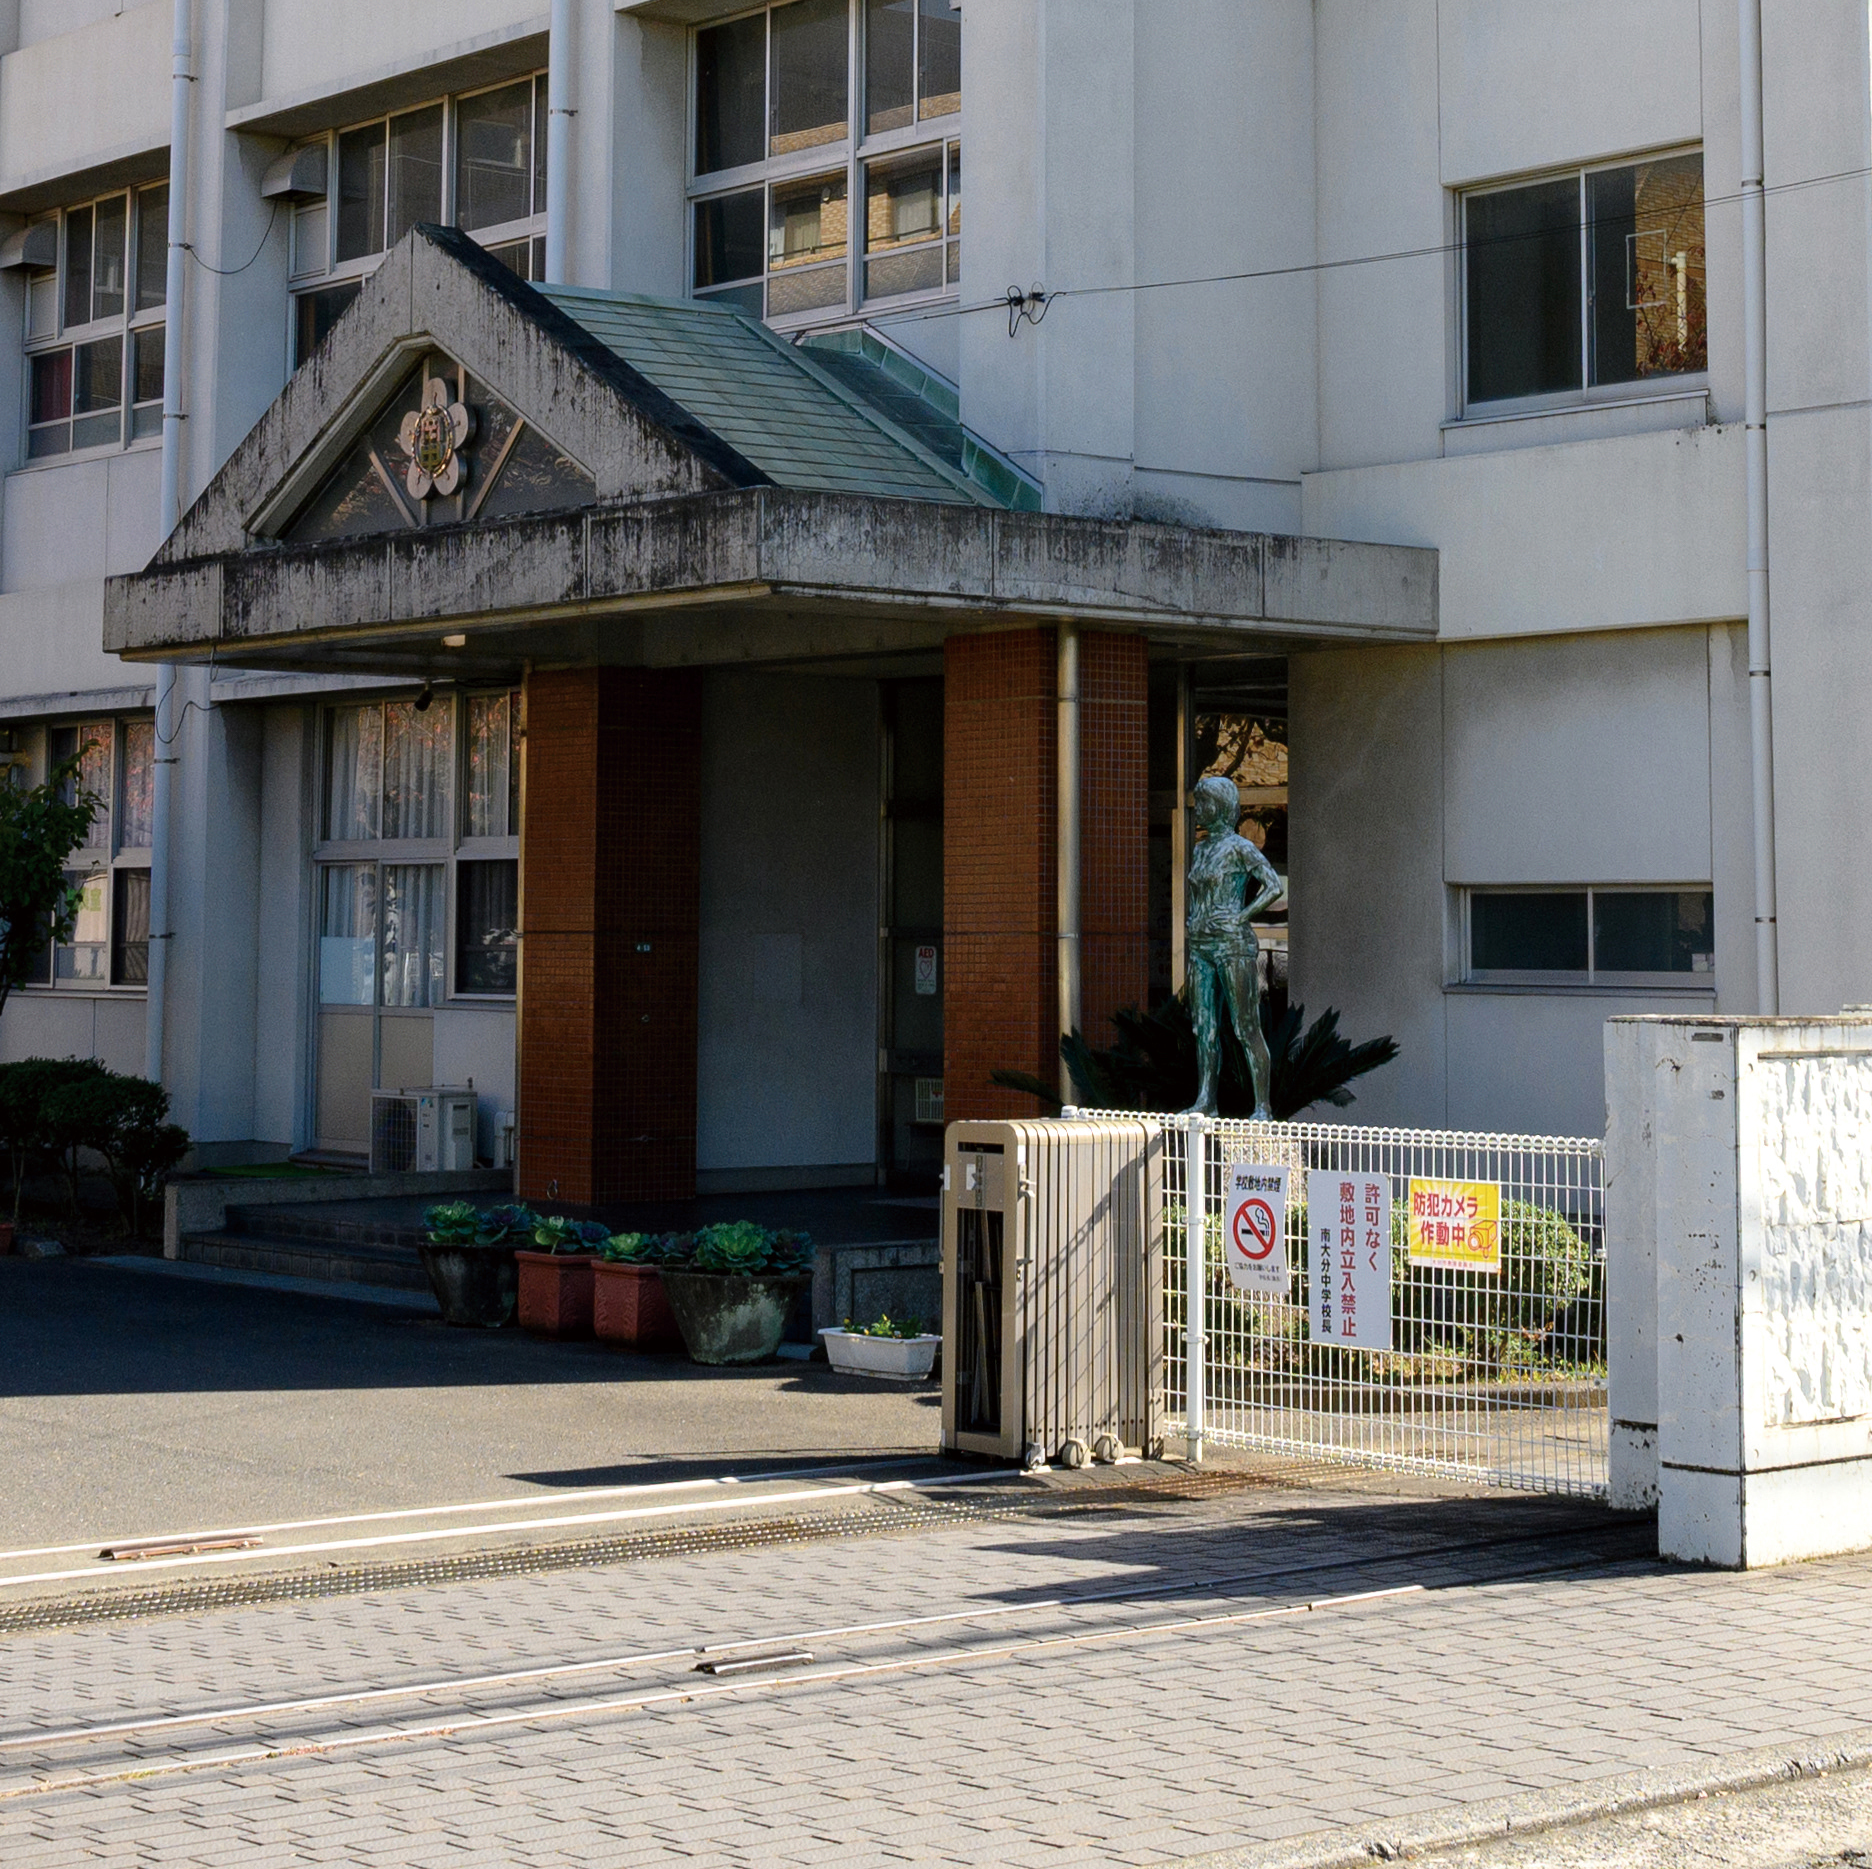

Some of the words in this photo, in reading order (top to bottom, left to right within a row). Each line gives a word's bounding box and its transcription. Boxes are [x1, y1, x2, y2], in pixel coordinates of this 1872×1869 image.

[918, 947, 934, 959] AED
[1235, 1174, 1282, 1193] 学校敷地内禁煙
[1413, 1191, 1479, 1219] 防犯カメラ
[1364, 1183, 1381, 1272] 許可なく
[1420, 1219, 1465, 1247] 作動中
[1339, 1182, 1357, 1338] 敷地内立入禁止
[1319, 1228, 1332, 1334] 南大分中学校長
